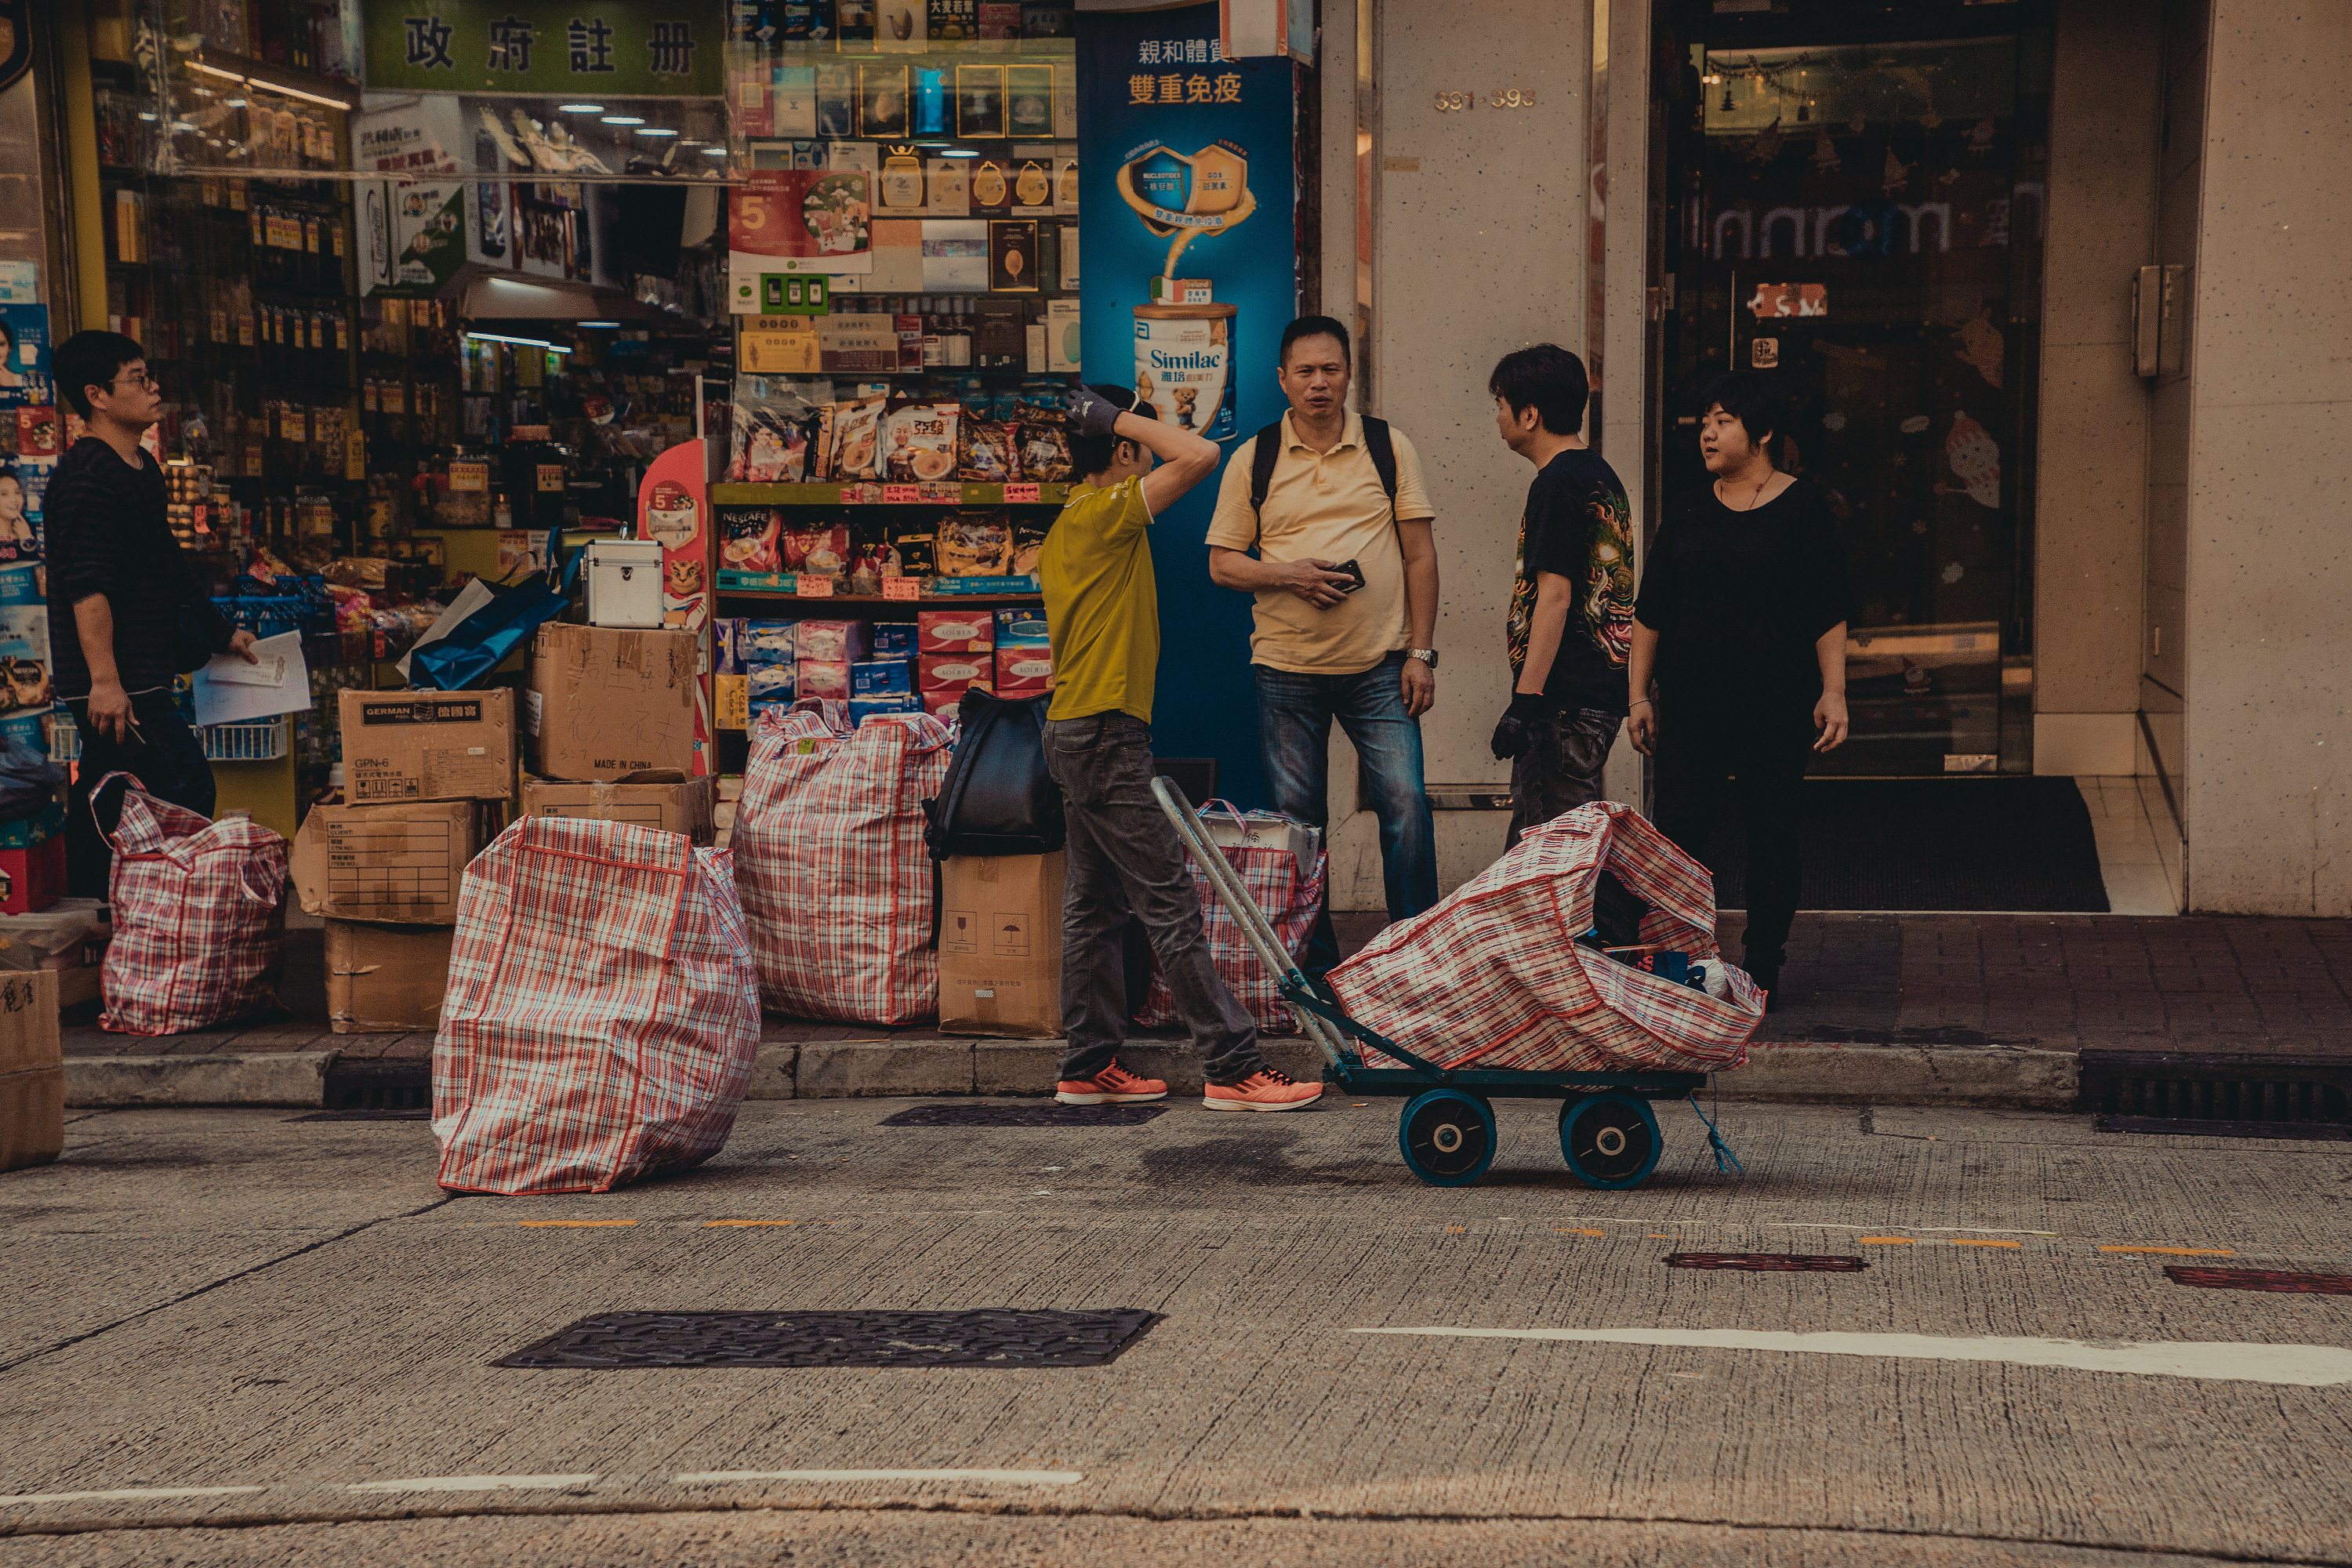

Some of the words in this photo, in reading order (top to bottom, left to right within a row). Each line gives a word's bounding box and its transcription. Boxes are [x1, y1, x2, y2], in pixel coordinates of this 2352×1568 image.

[1128, 72, 1242, 105] 雙重免疫
[1151, 350, 1220, 369] Similac
[1161, 371, 1185, 383] 雅培
[366, 707, 411, 716] GERMAN
[355, 758, 389, 768] GPN-6
[594, 759, 616, 768] MADE
[619, 760, 626, 768] IN
[630, 760, 652, 769] CHINA
